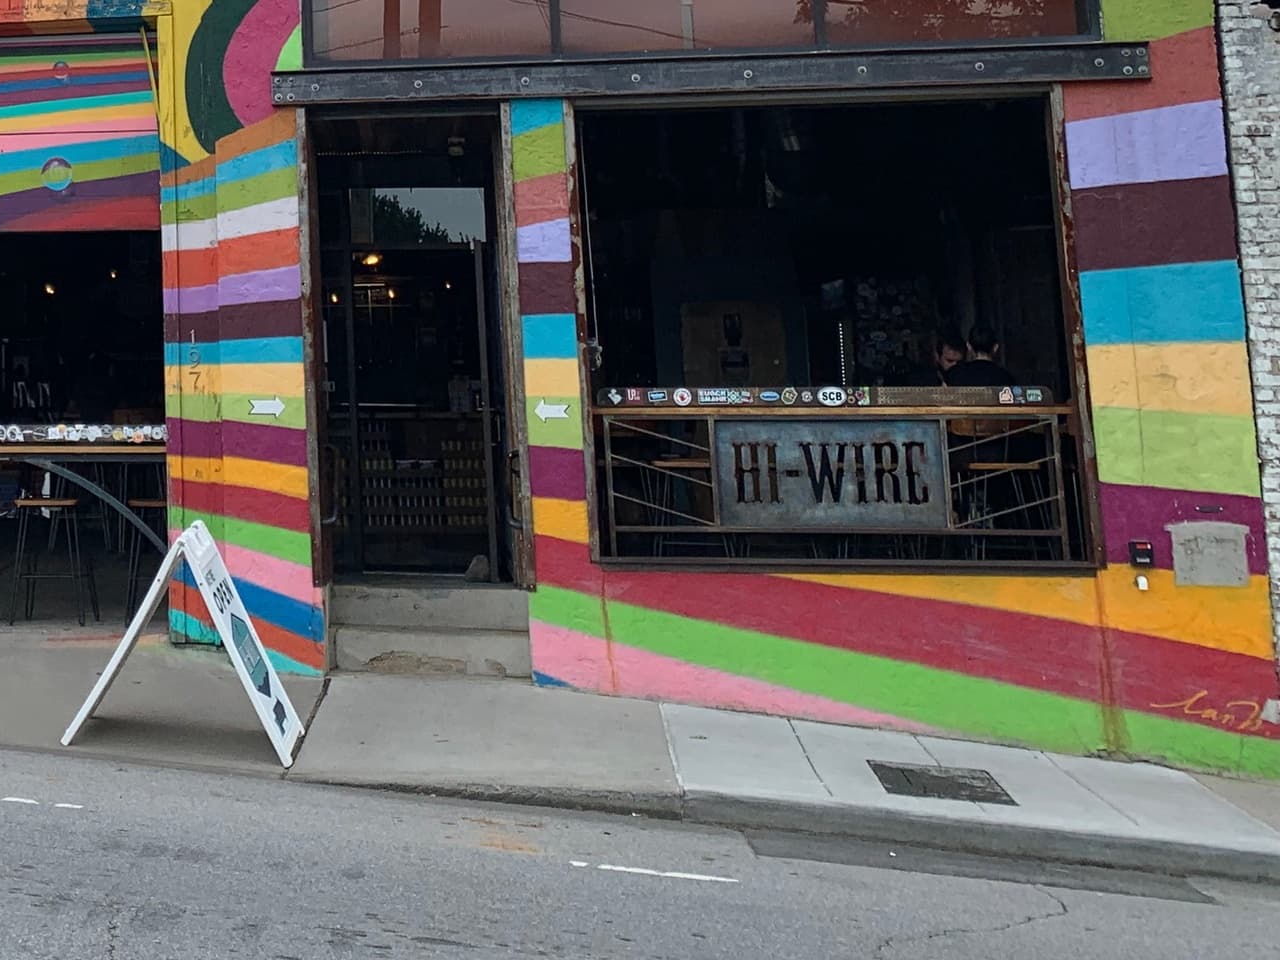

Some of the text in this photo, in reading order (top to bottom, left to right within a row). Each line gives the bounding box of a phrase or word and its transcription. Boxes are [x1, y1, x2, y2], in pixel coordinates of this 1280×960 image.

[821, 391, 843, 401] SCB
[732, 441, 930, 506] HI-WIRE
[213, 577, 234, 615] OPEN
